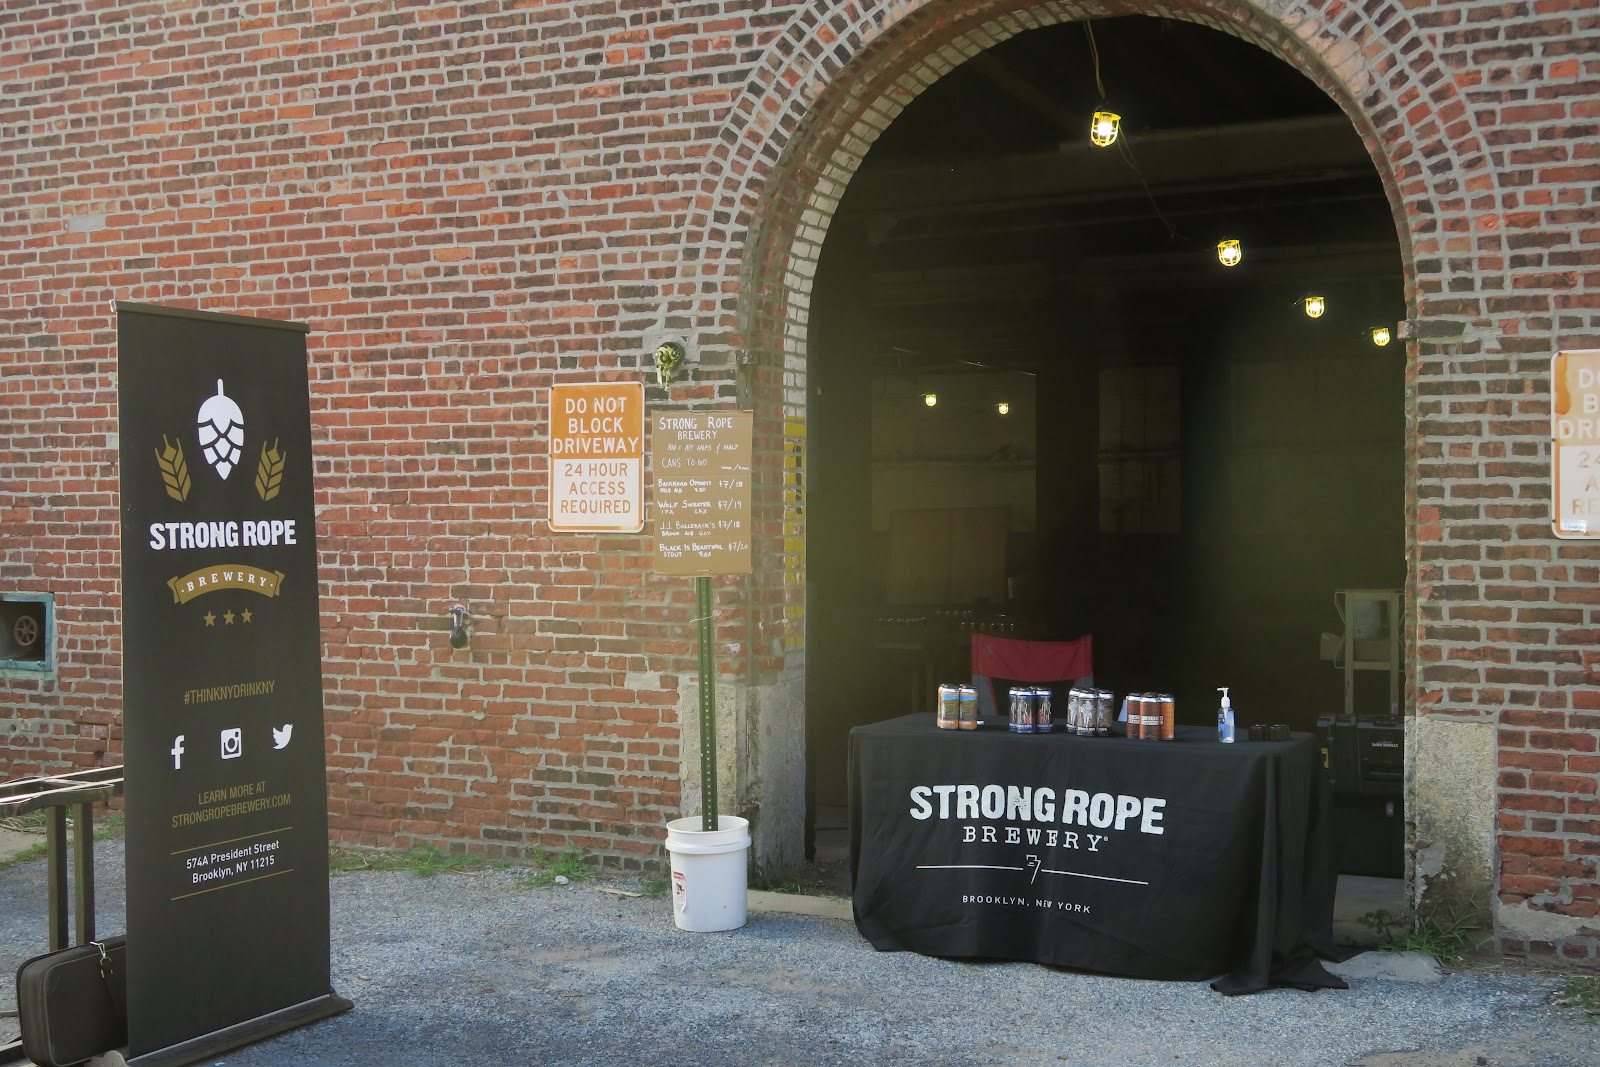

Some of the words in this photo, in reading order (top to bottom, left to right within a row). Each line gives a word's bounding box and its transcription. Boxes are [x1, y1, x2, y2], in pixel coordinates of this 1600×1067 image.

[565, 397, 587, 414] DO
[594, 396, 627, 414] NOT
[568, 417, 624, 434] BLOCK
[659, 417, 698, 430] STRONG
[708, 416, 733, 429] ROPE
[677, 430, 718, 440] BREWERY
[553, 436, 639, 454] DRIVEWAY
[564, 463, 583, 477] 24
[588, 462, 628, 477] HOUR
[661, 457, 681, 468] CANS
[686, 458, 695, 466] TO
[697, 458, 708, 467] GO
[568, 481, 626, 496] ACCESS
[658, 479, 688, 487] BACKROAD
[560, 499, 631, 514] REQUIRED
[657, 500, 679, 508] WOLF
[681, 500, 712, 508] SWEATER
[150, 521, 239, 550] STRONG
[243, 519, 297, 547] ROPE
[659, 543, 682, 552] BLACK
[684, 543, 691, 551] IS
[186, 571, 267, 592] BREWERY
[183, 680, 275, 705] #THINKNYDRINKNY
[198, 788, 227, 805] LEARN
[229, 783, 254, 798] MORE
[255, 781, 266, 794] AT
[172, 793, 291, 828] STRONGROPEBREWERY.COM
[909, 784, 1056, 823] STRONG
[1061, 788, 1167, 835] ROPE
[186, 854, 209, 870] 574A
[210, 846, 252, 867] President
[253, 840, 280, 854] Street
[192, 865, 234, 884] Brooklyn,
[236, 861, 249, 873] NY
[250, 855, 275, 871] 11215
[962, 895, 1030, 907] BROOKLYN,
[1035, 899, 1053, 909] NEW
[1057, 902, 1091, 914] YORK
